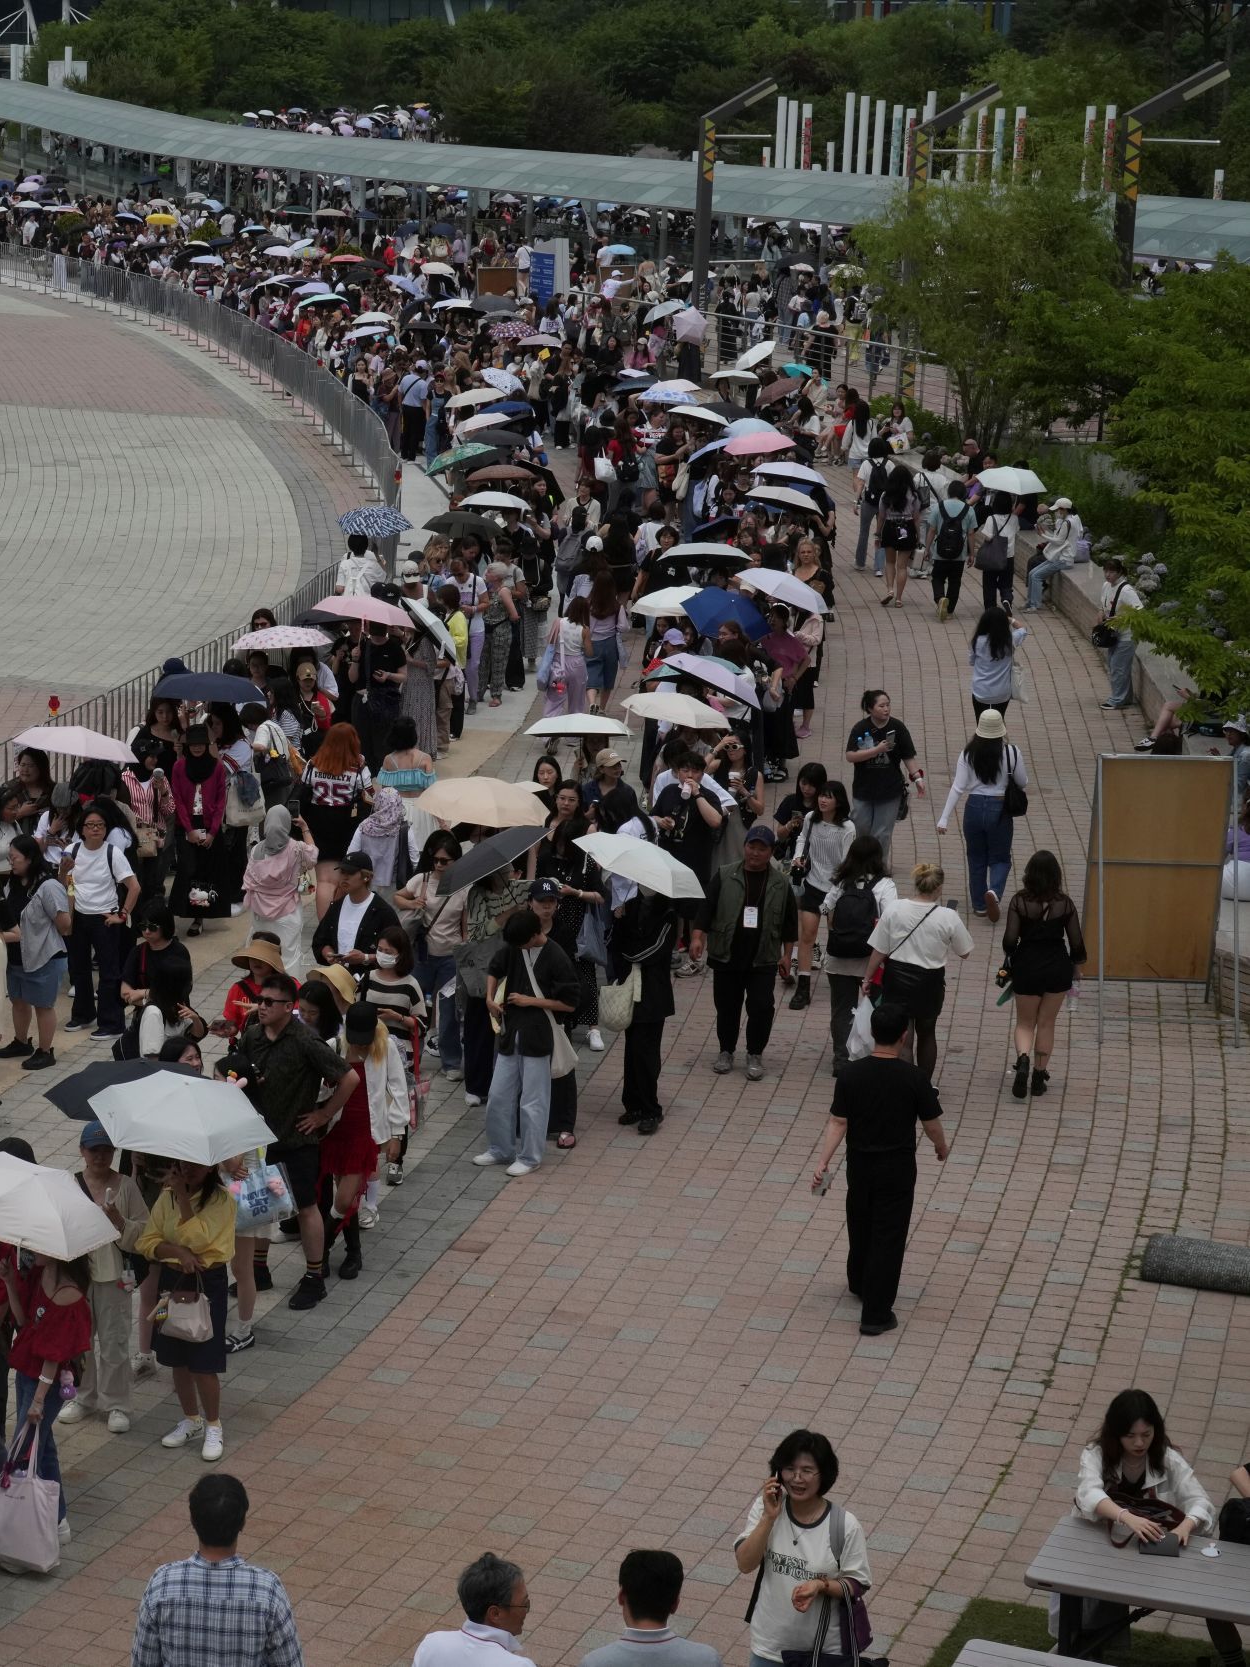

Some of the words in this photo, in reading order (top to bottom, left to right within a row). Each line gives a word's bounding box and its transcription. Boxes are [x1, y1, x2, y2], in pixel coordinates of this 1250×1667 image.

[314, 781, 352, 807] 25
[248, 1197, 269, 1208] LET
[252, 1205, 268, 1217] GO
[772, 1563, 792, 1576] YOU
